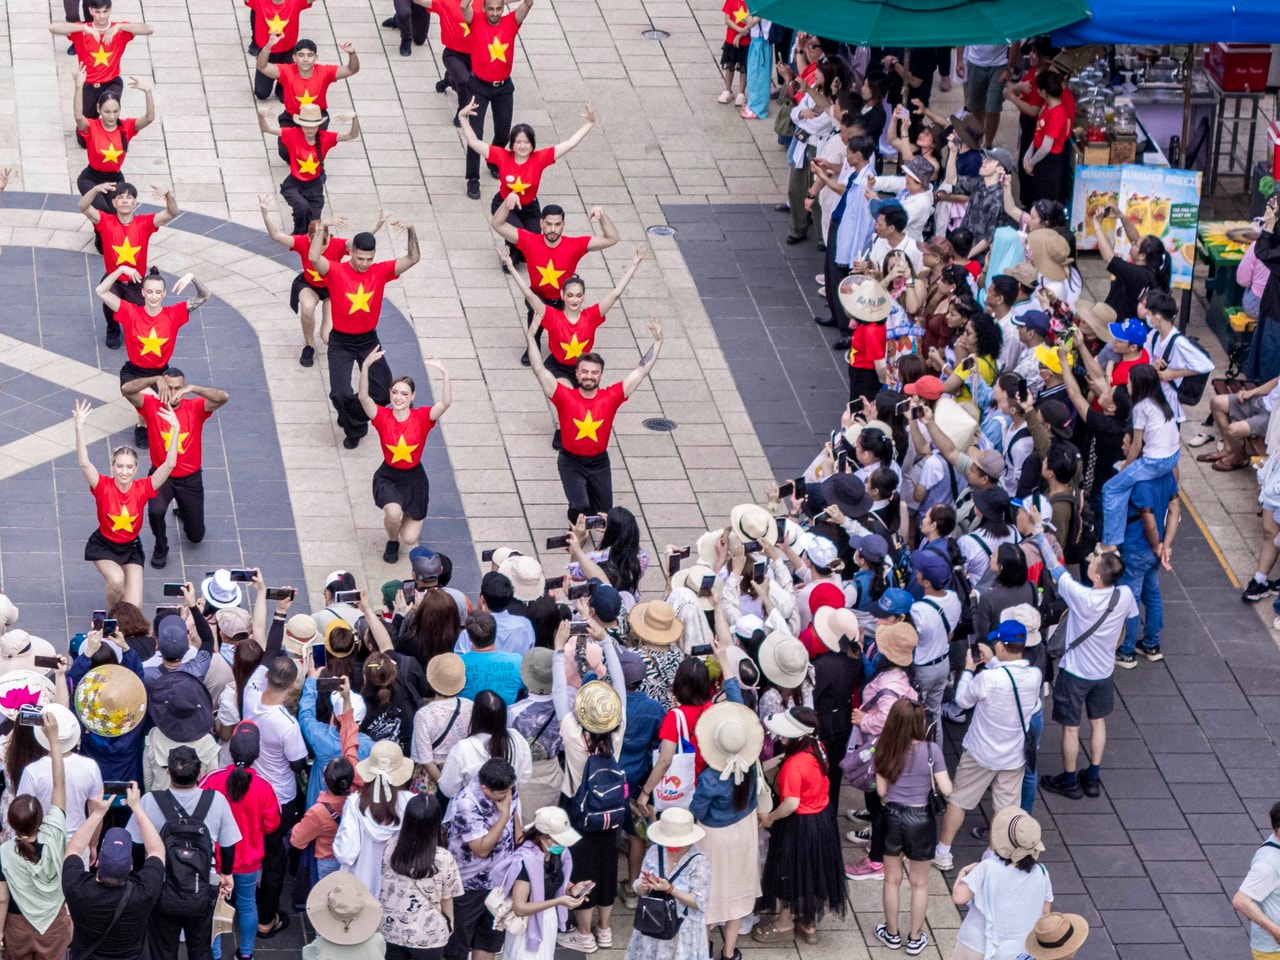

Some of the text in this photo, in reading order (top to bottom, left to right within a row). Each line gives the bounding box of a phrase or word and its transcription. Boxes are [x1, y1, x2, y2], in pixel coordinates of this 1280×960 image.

[1122, 169, 1163, 181] SUMMER
[466, 661, 515, 673] st. 1969
